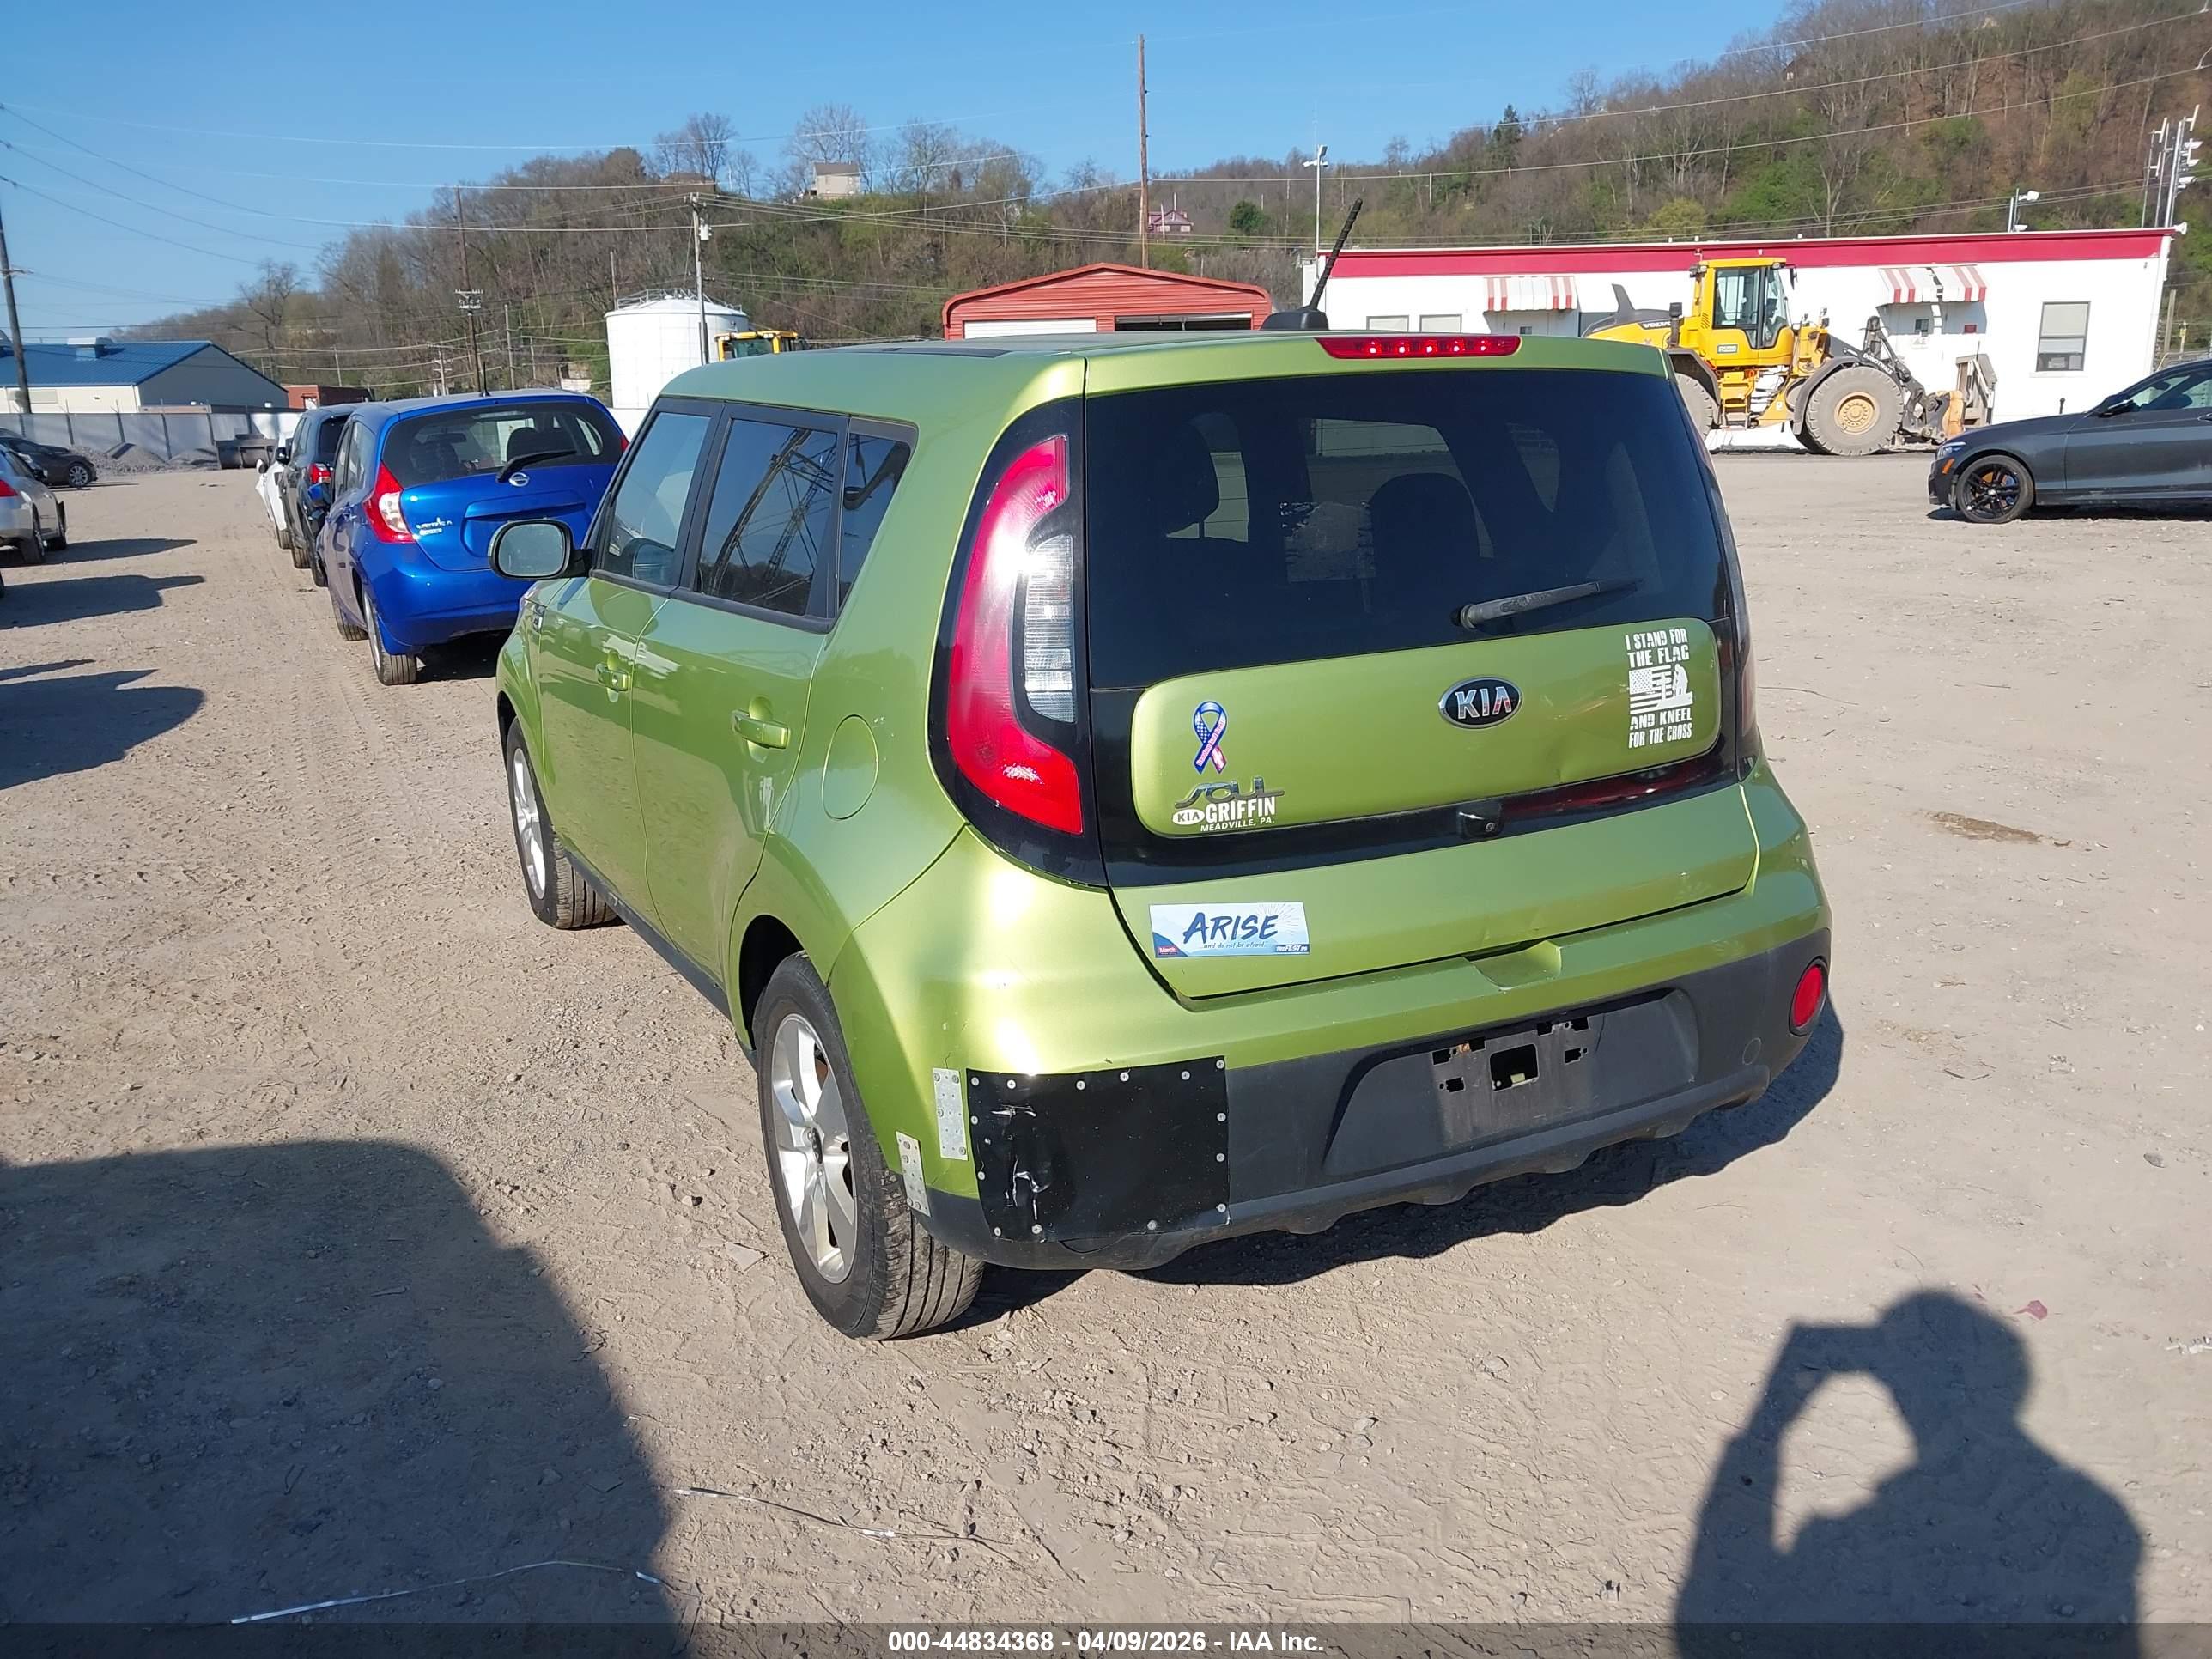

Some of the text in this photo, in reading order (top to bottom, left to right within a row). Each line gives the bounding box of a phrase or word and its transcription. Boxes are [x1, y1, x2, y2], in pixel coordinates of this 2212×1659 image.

[1625, 628, 1688, 650] I STAND FOR
[1627, 644, 1690, 668] THE FLAG
[1455, 686, 1512, 720] KIA
[1630, 707, 1692, 730] AND KNEEL
[1628, 722, 1692, 749] FOR THE CROSS
[1205, 796, 1276, 824] GRIFFIN
